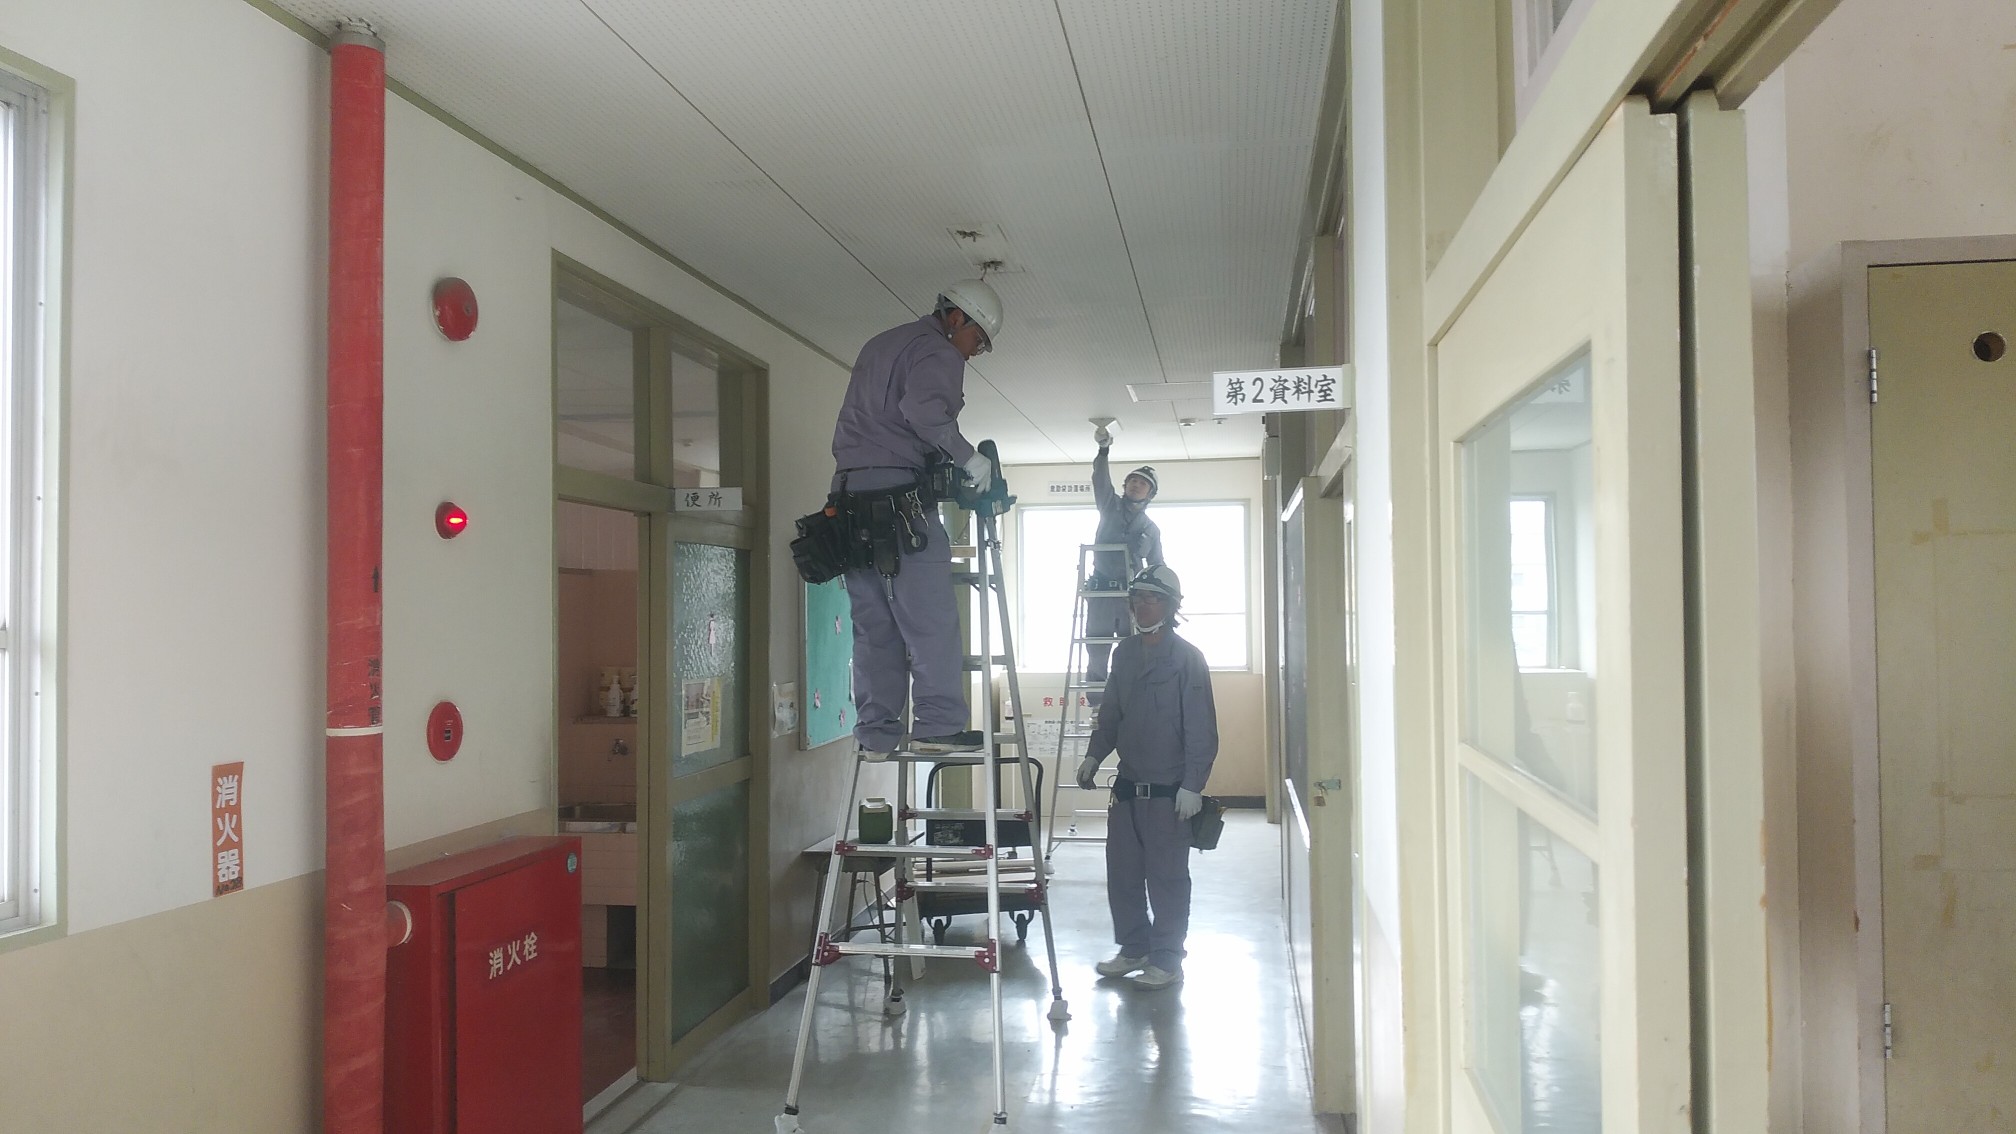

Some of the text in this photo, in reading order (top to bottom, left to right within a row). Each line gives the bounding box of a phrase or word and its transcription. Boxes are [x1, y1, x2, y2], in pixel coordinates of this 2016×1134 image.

[1226, 374, 1336, 405] 第2資料室
[685, 491, 722, 508] 便所
[216, 775, 240, 882] 消火器
[489, 932, 538, 980] 消火栓
